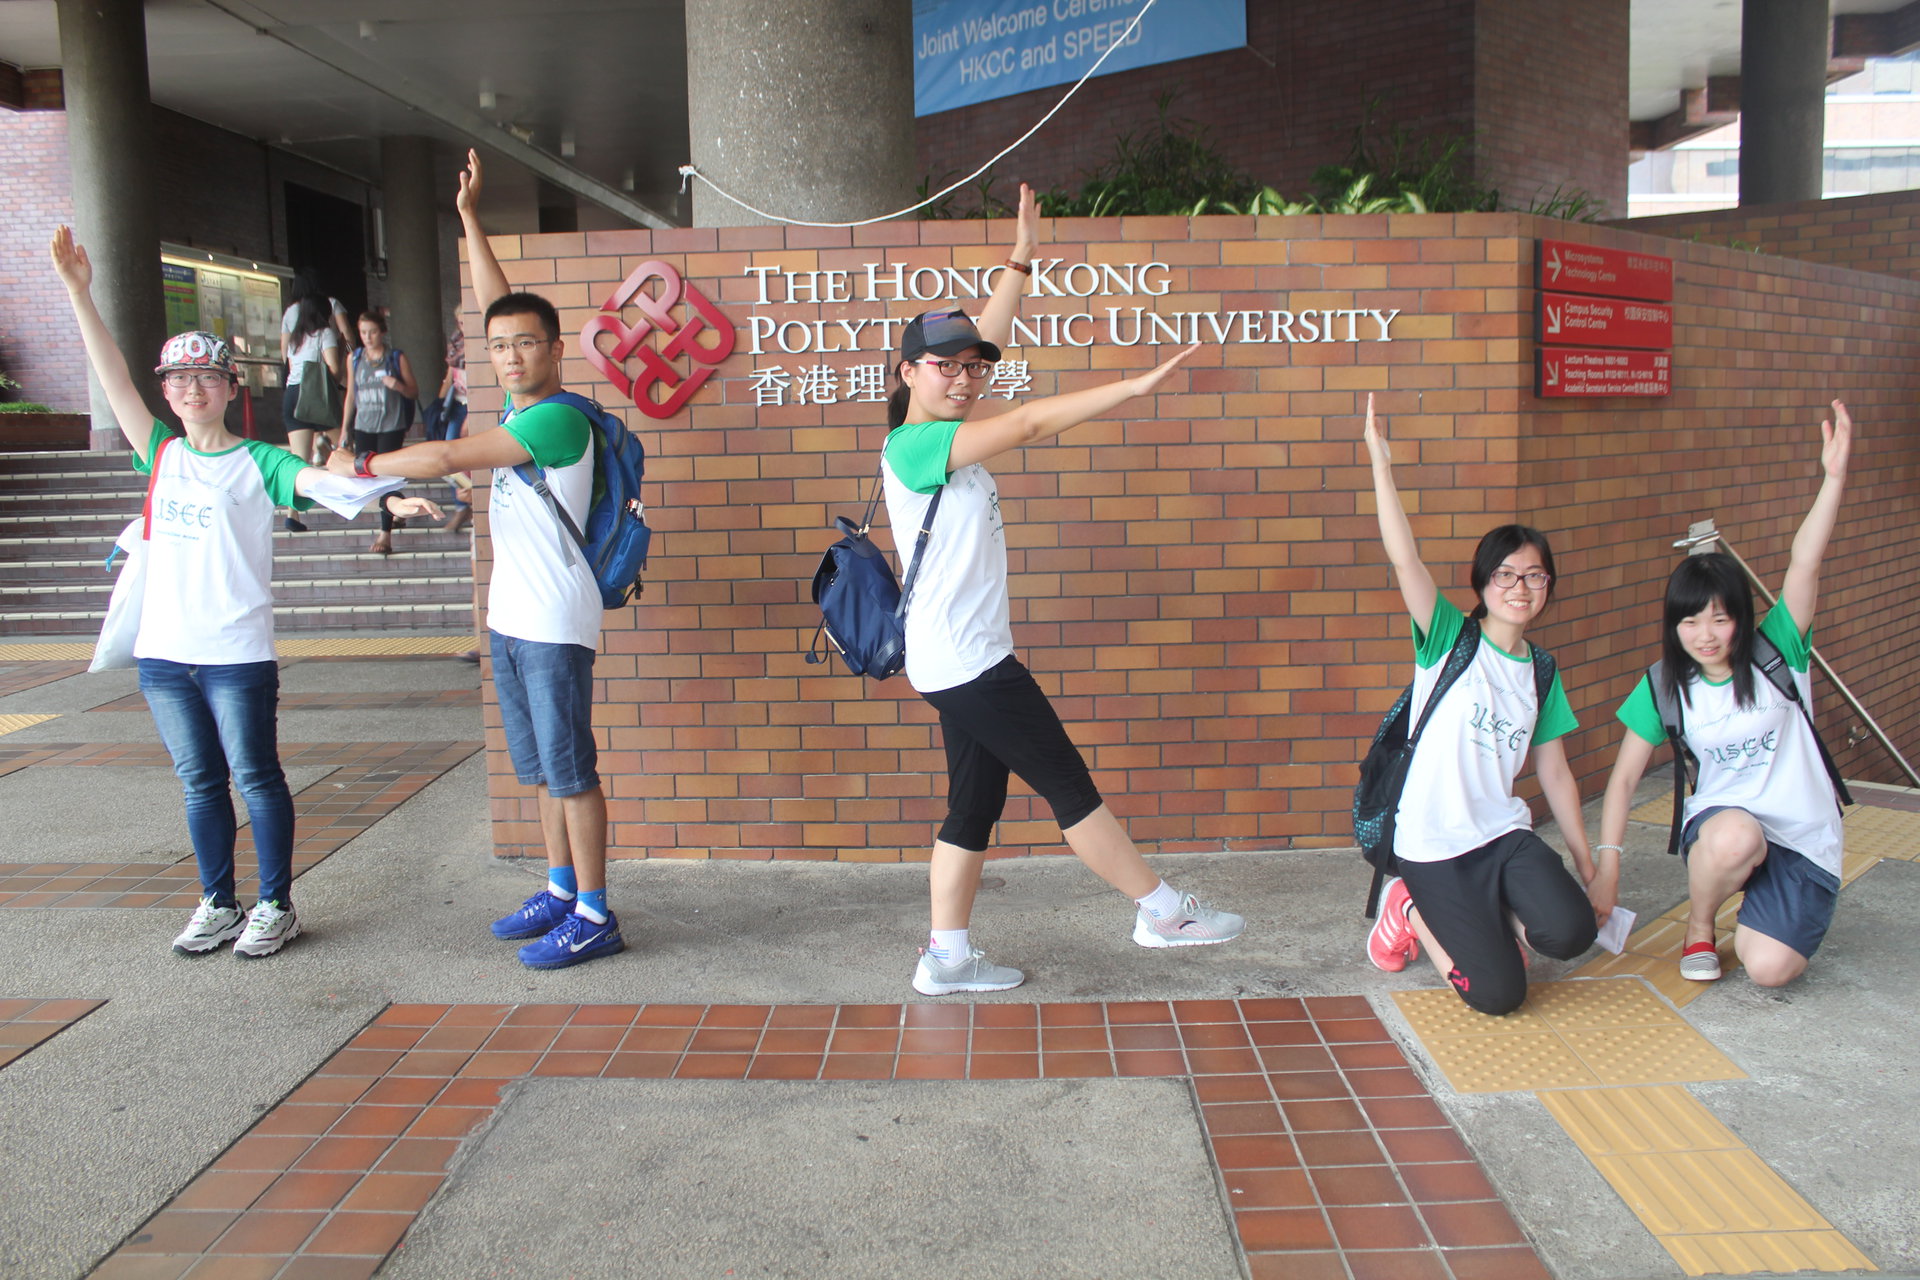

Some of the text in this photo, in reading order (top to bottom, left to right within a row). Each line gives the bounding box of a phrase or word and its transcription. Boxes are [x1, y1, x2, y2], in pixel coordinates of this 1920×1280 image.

[918, 28, 959, 60] Joint
[962, 5, 1047, 45] Welcome
[1053, 0, 1156, 21] Cere
[959, 16, 1143, 85] HKCC and SPEED
[744, 264, 851, 305] THE
[1027, 258, 1172, 298] KONG
[168, 335, 224, 363] BOY
[747, 306, 1400, 355] POLYTNIC UNIVERSITY
[749, 359, 1032, 407] 香港理學
